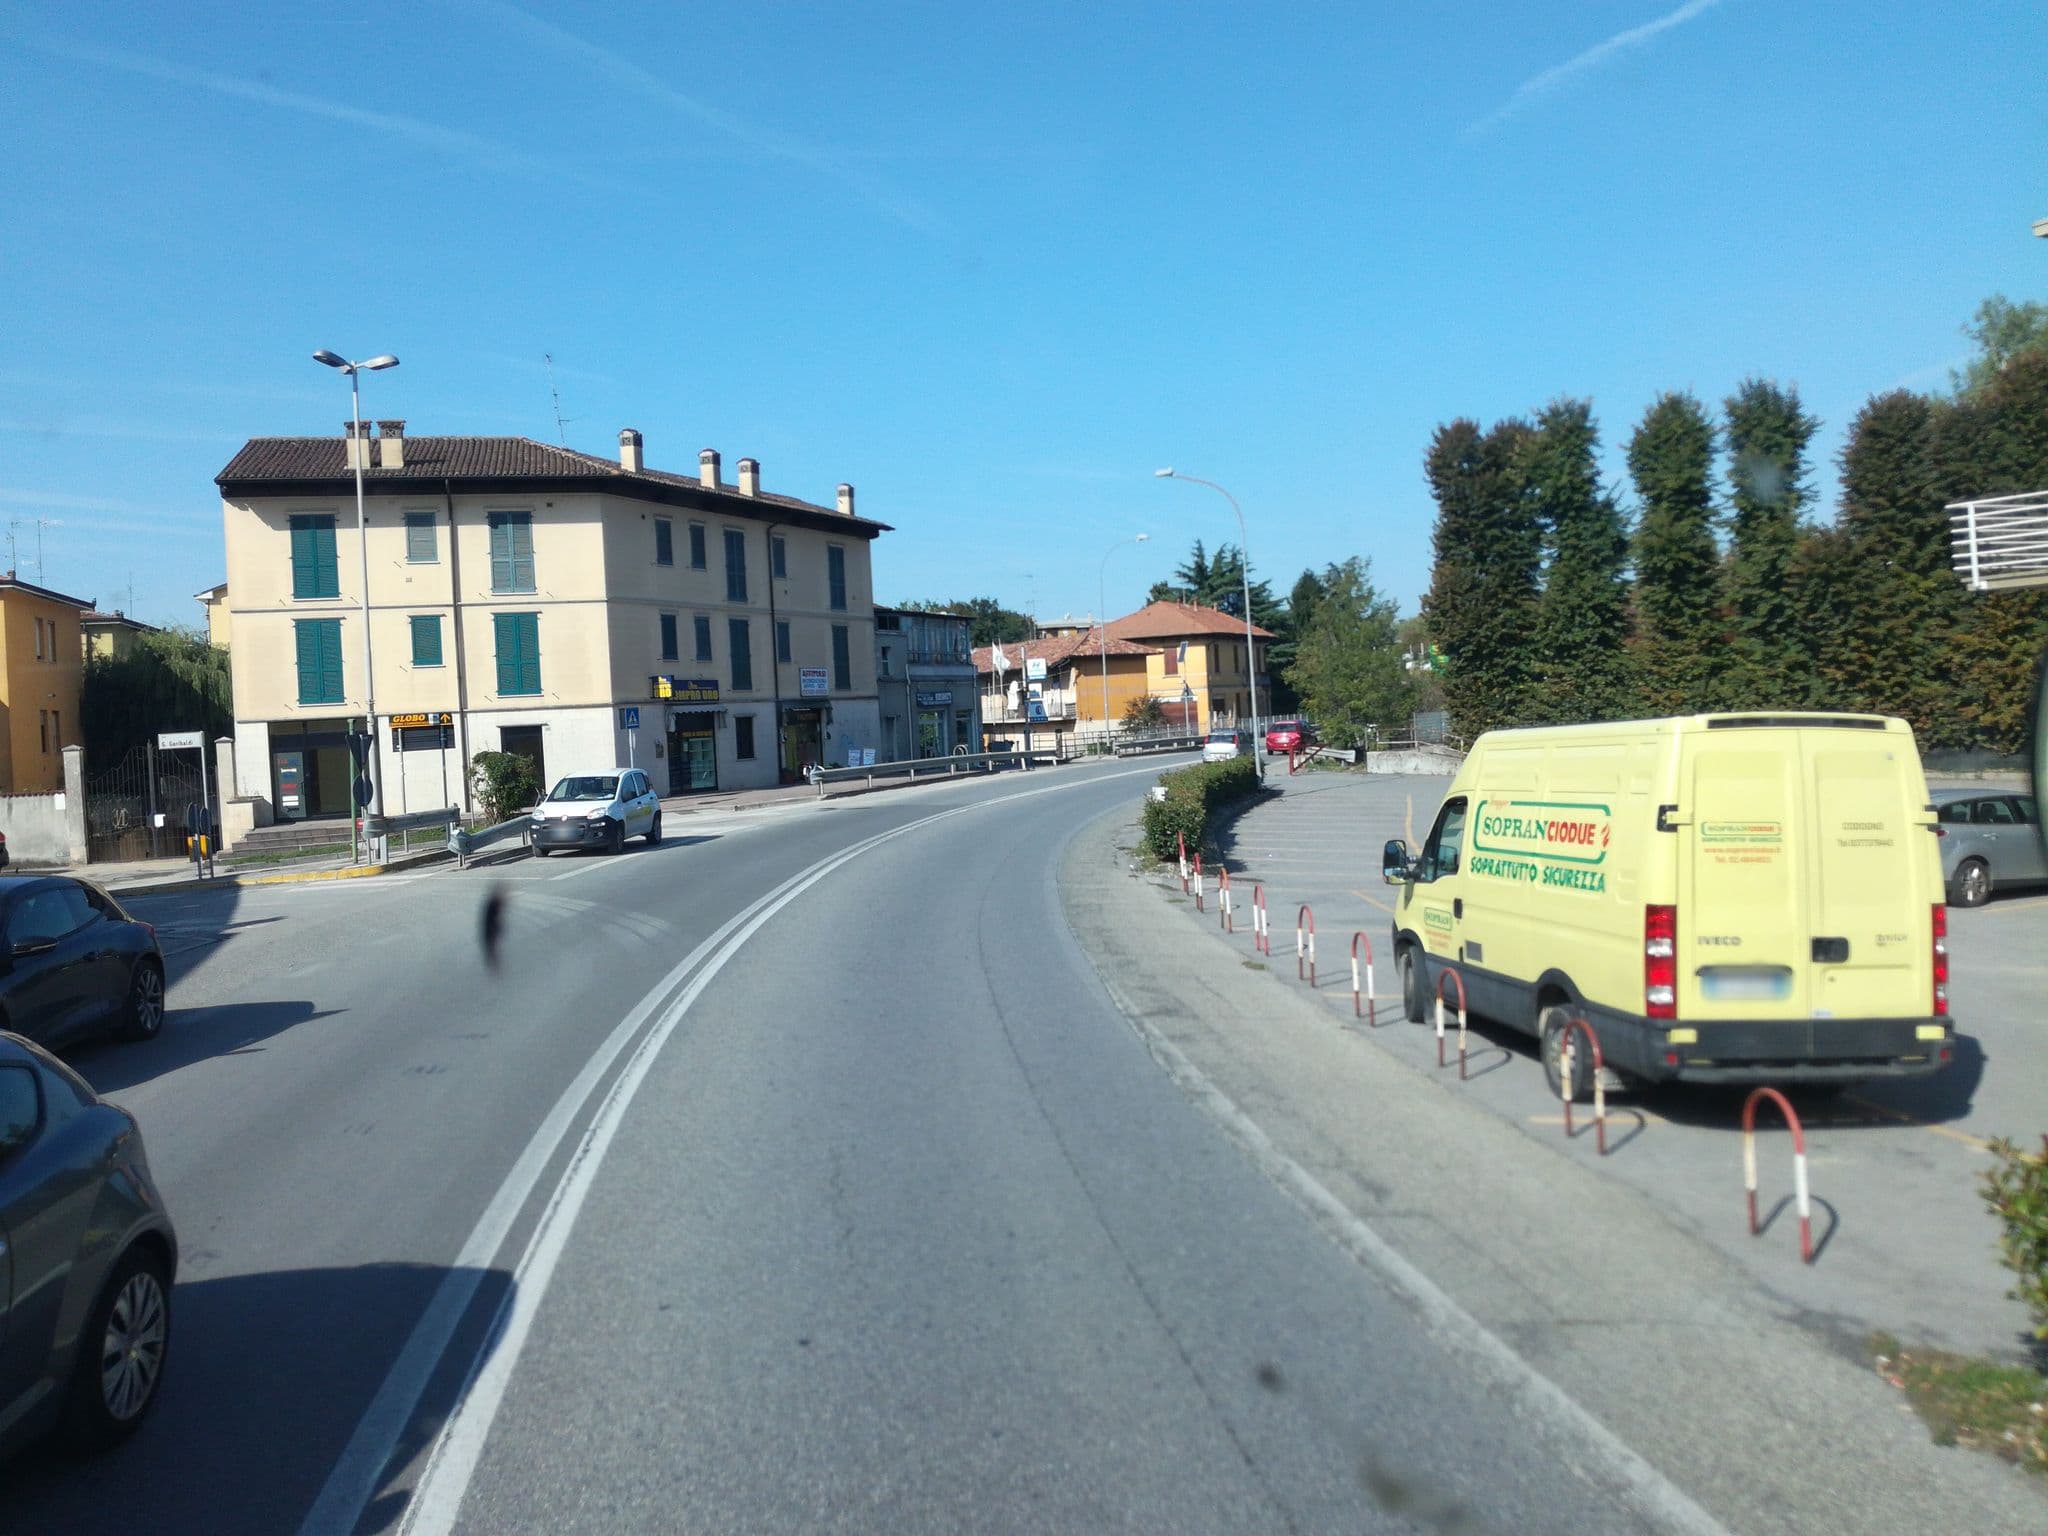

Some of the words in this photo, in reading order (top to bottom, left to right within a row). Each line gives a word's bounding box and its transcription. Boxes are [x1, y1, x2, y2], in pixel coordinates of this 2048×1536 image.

[393, 714, 425, 722] GLOBO
[1482, 816, 1597, 845] SOPRANCIODUE
[1470, 856, 1538, 882] SOPRATTUTTO
[1542, 865, 1606, 892] SICUREZZA
[1697, 936, 1742, 946] IVECO
